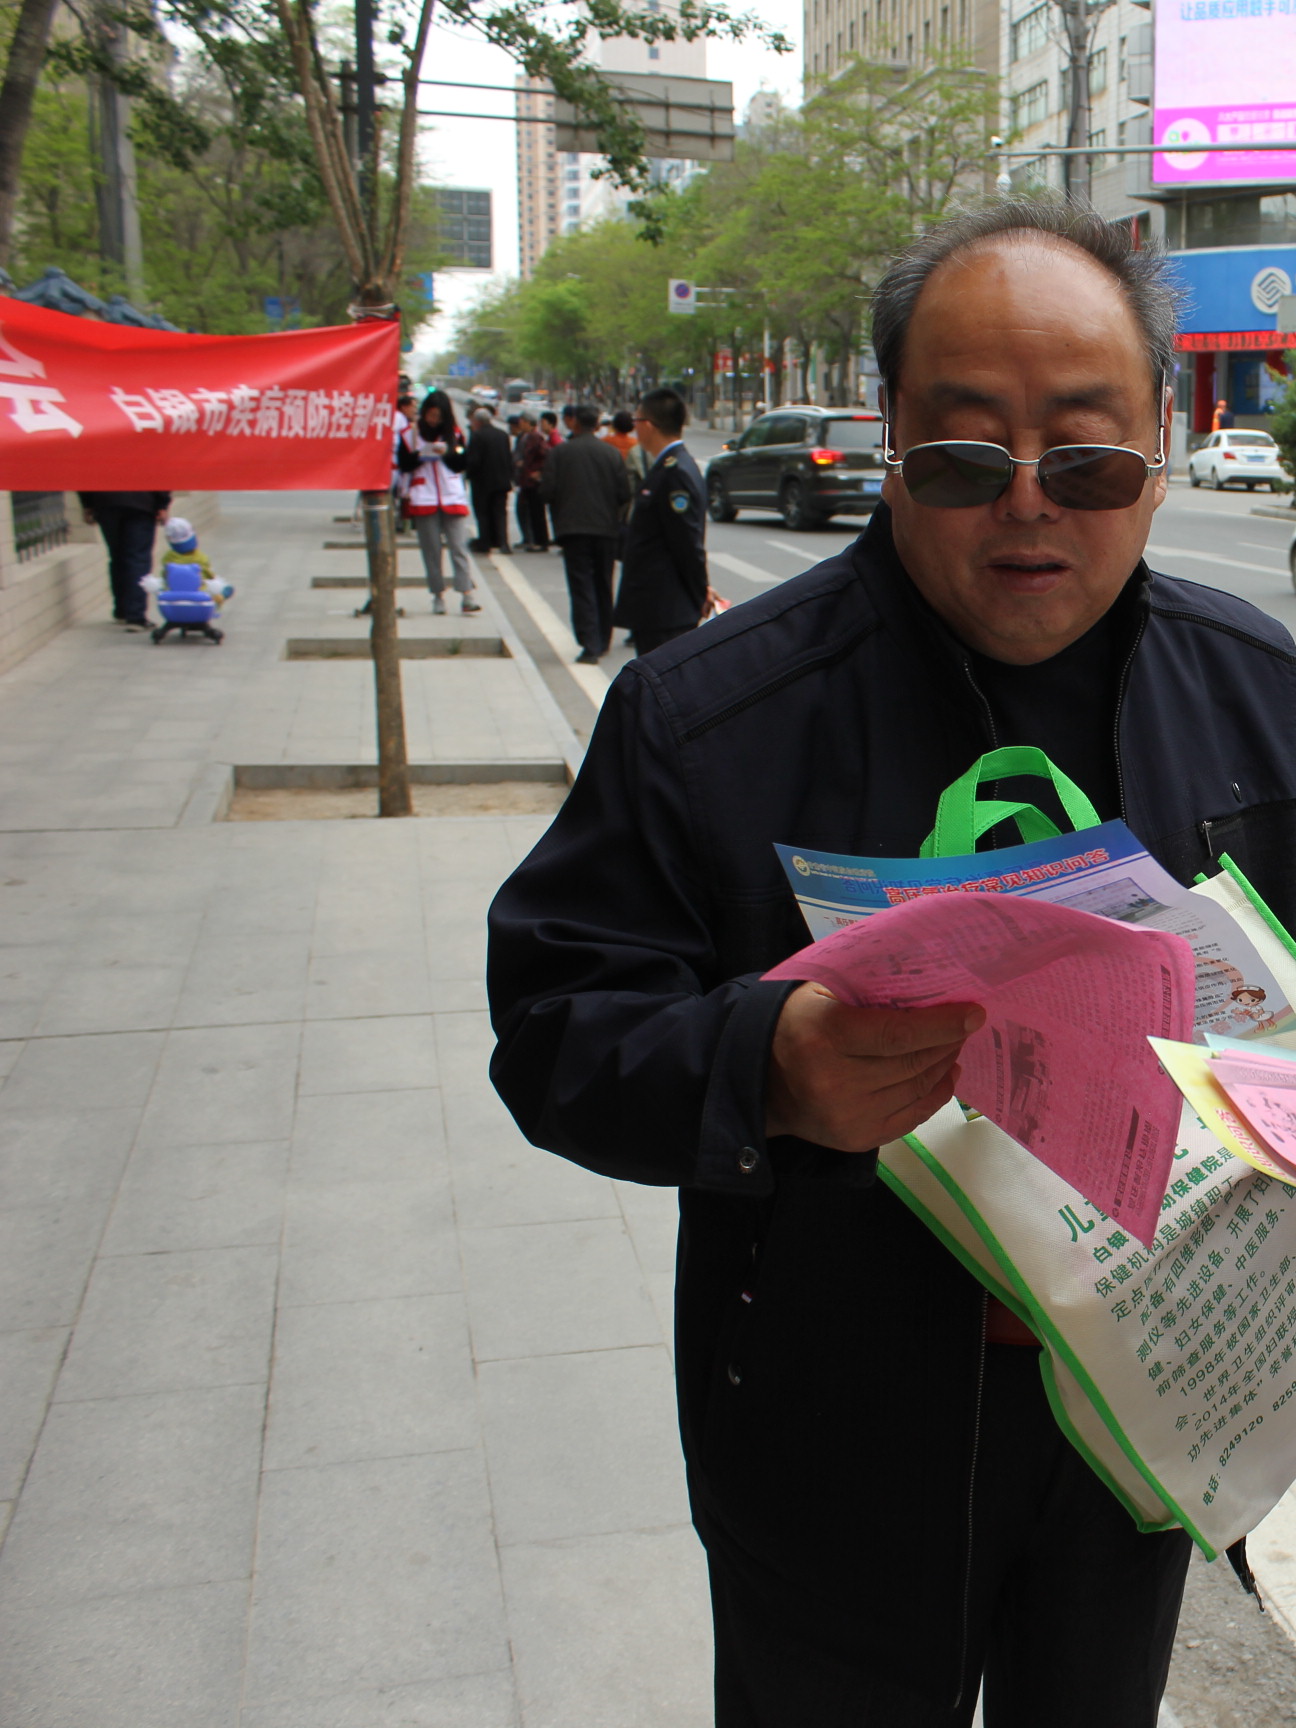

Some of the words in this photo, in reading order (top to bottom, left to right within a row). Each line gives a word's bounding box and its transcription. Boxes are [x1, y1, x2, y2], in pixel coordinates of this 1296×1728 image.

[109, 384, 392, 440] 白银市疾病预防控制中
[1136, 1176, 1273, 1363] 测仪等先进设备。开展了妇
